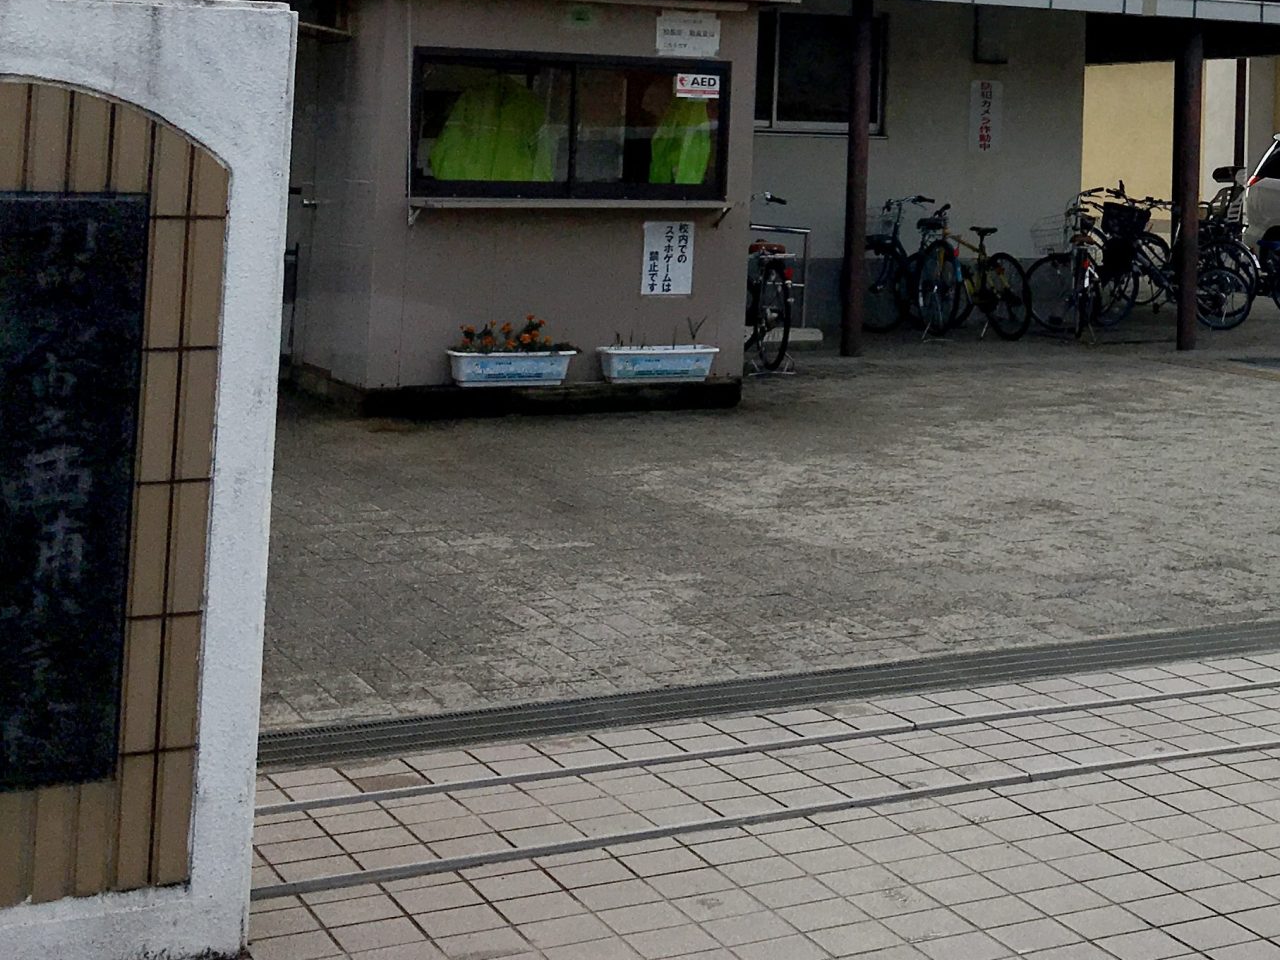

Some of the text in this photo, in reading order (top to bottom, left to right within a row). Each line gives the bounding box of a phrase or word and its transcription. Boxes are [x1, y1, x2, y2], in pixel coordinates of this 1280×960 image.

[691, 76, 717, 88] AED
[979, 82, 992, 151] 防犯カメラ作動中
[662, 226, 674, 292] スマホゲームは
[677, 223, 689, 264] 校内での
[648, 251, 659, 292] 禁止です
